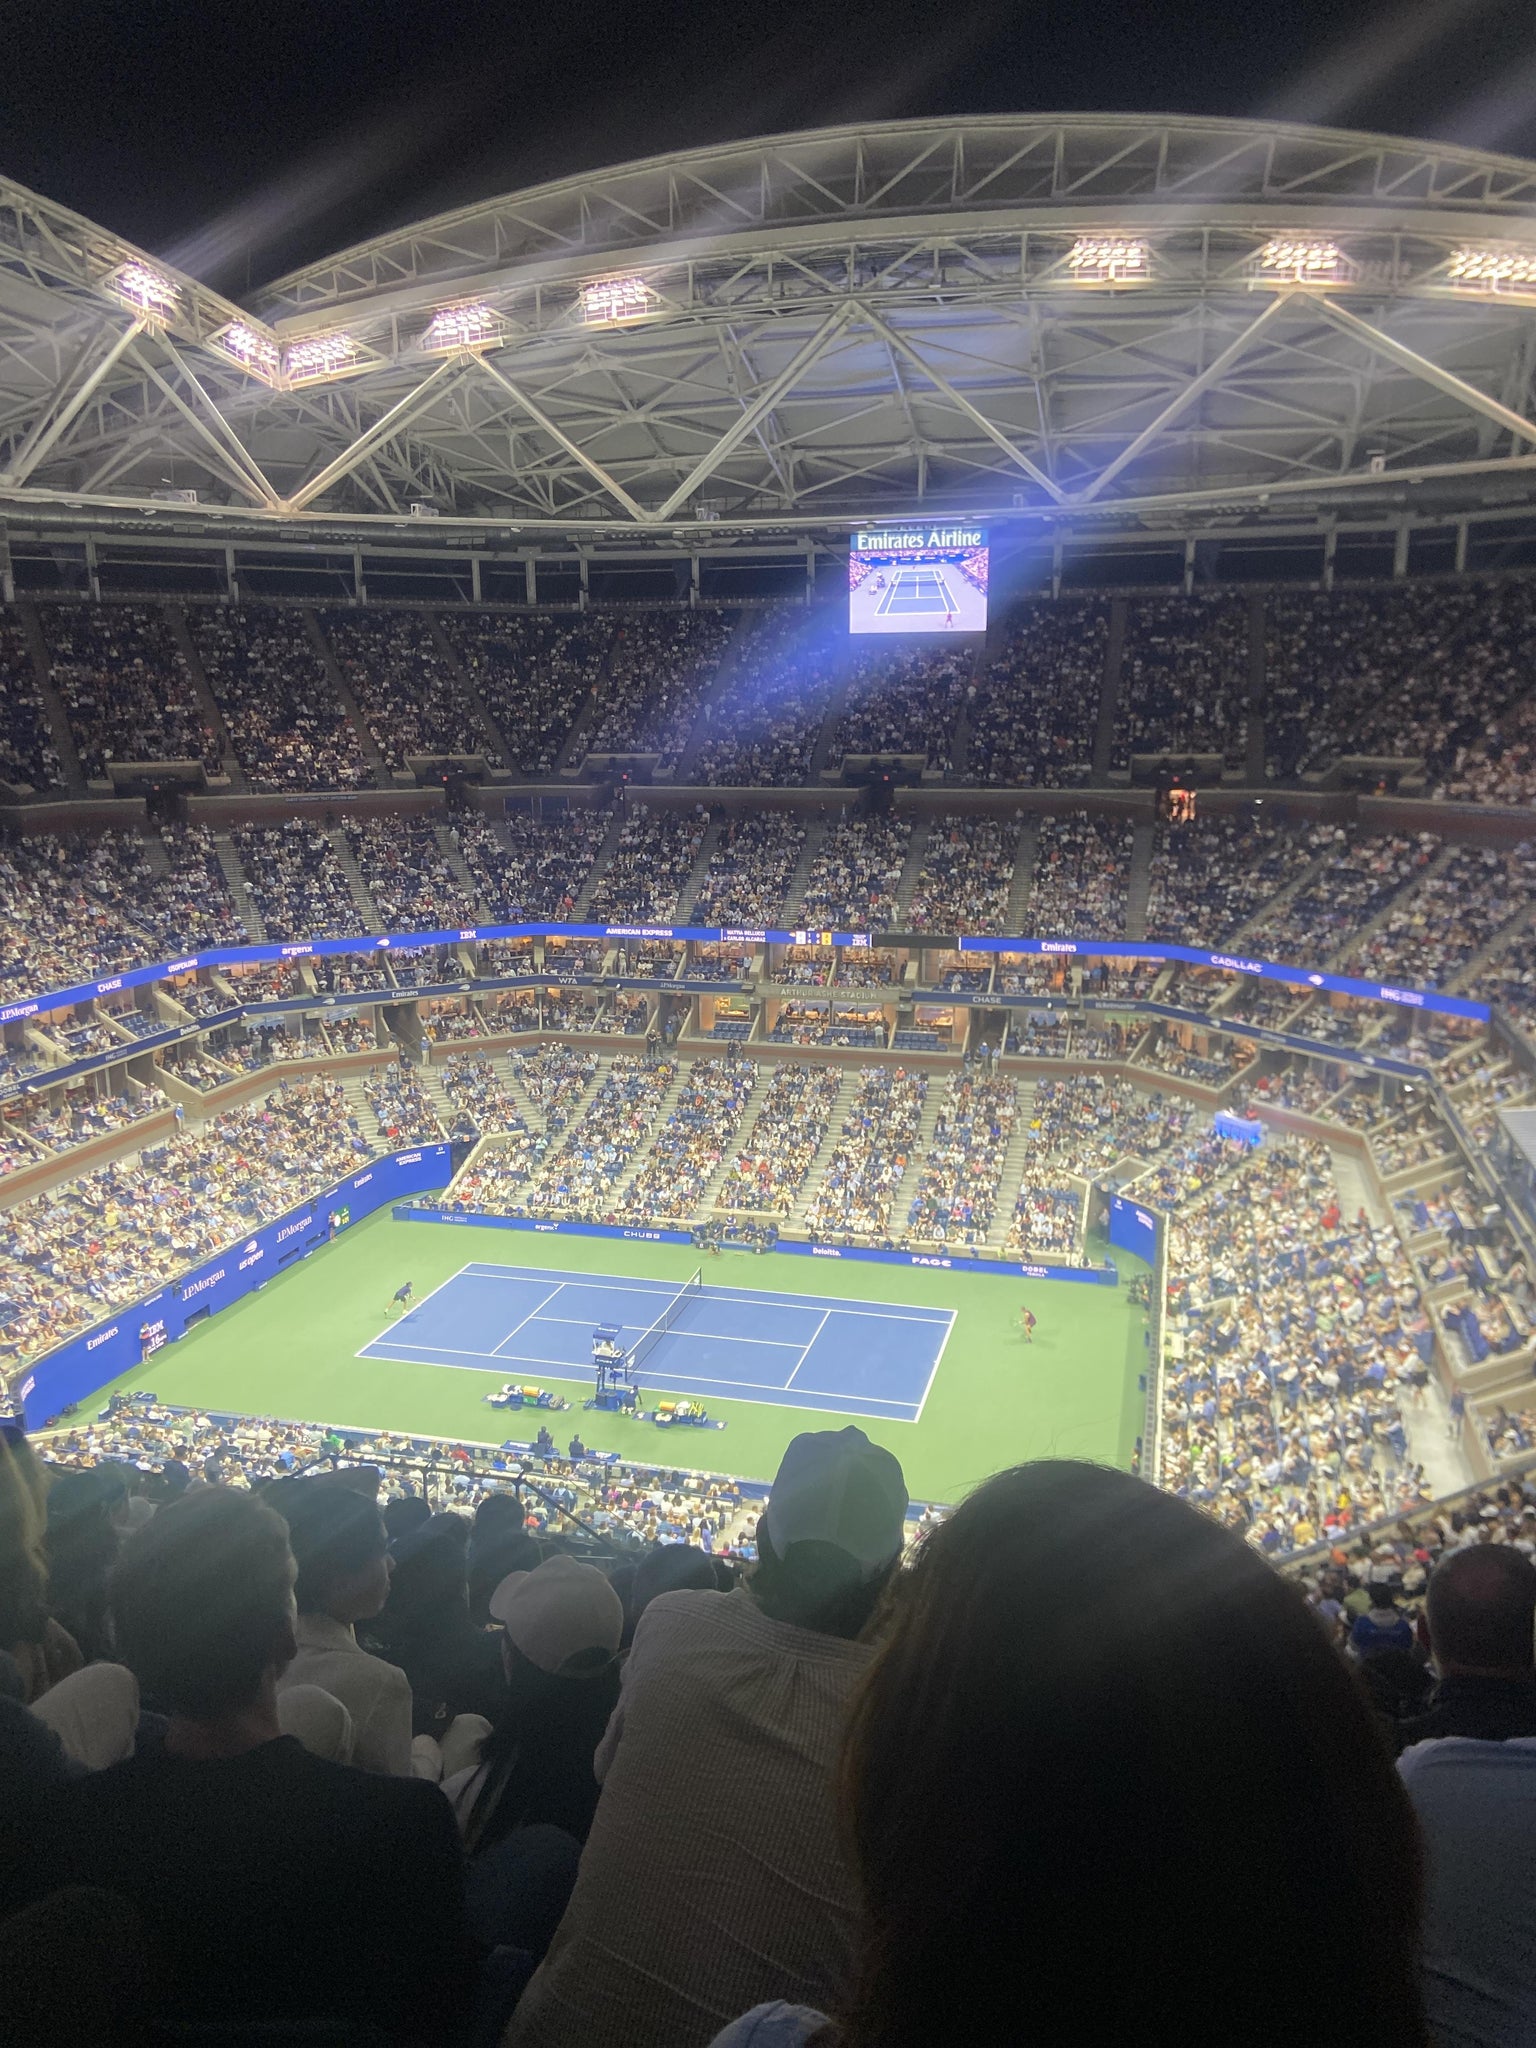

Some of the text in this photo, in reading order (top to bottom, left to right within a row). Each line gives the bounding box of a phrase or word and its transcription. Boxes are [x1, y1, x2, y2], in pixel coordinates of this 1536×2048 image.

[857, 531, 982, 550] Emirates Airline
[460, 930, 476, 940] IBM
[606, 928, 673, 937] AMERICAN EXPRESS
[282, 945, 313, 956] argenx
[1041, 942, 1077, 952] Emirates
[1211, 955, 1263, 973] CADILLAC
[558, 977, 578, 985] WTA
[97, 980, 122, 993] CHASE
[392, 990, 419, 998] Emirates
[781, 988, 877, 999] ARTHUR ASHE STADIUM
[973, 995, 1001, 1004] CHASE
[277, 1216, 312, 1243] J.P.Morgan
[624, 1231, 660, 1239] CHUBB
[1022, 1266, 1048, 1274] DOBEL
[182, 1269, 225, 1301] J.P.Morgan
[87, 1326, 119, 1350] Emirates
